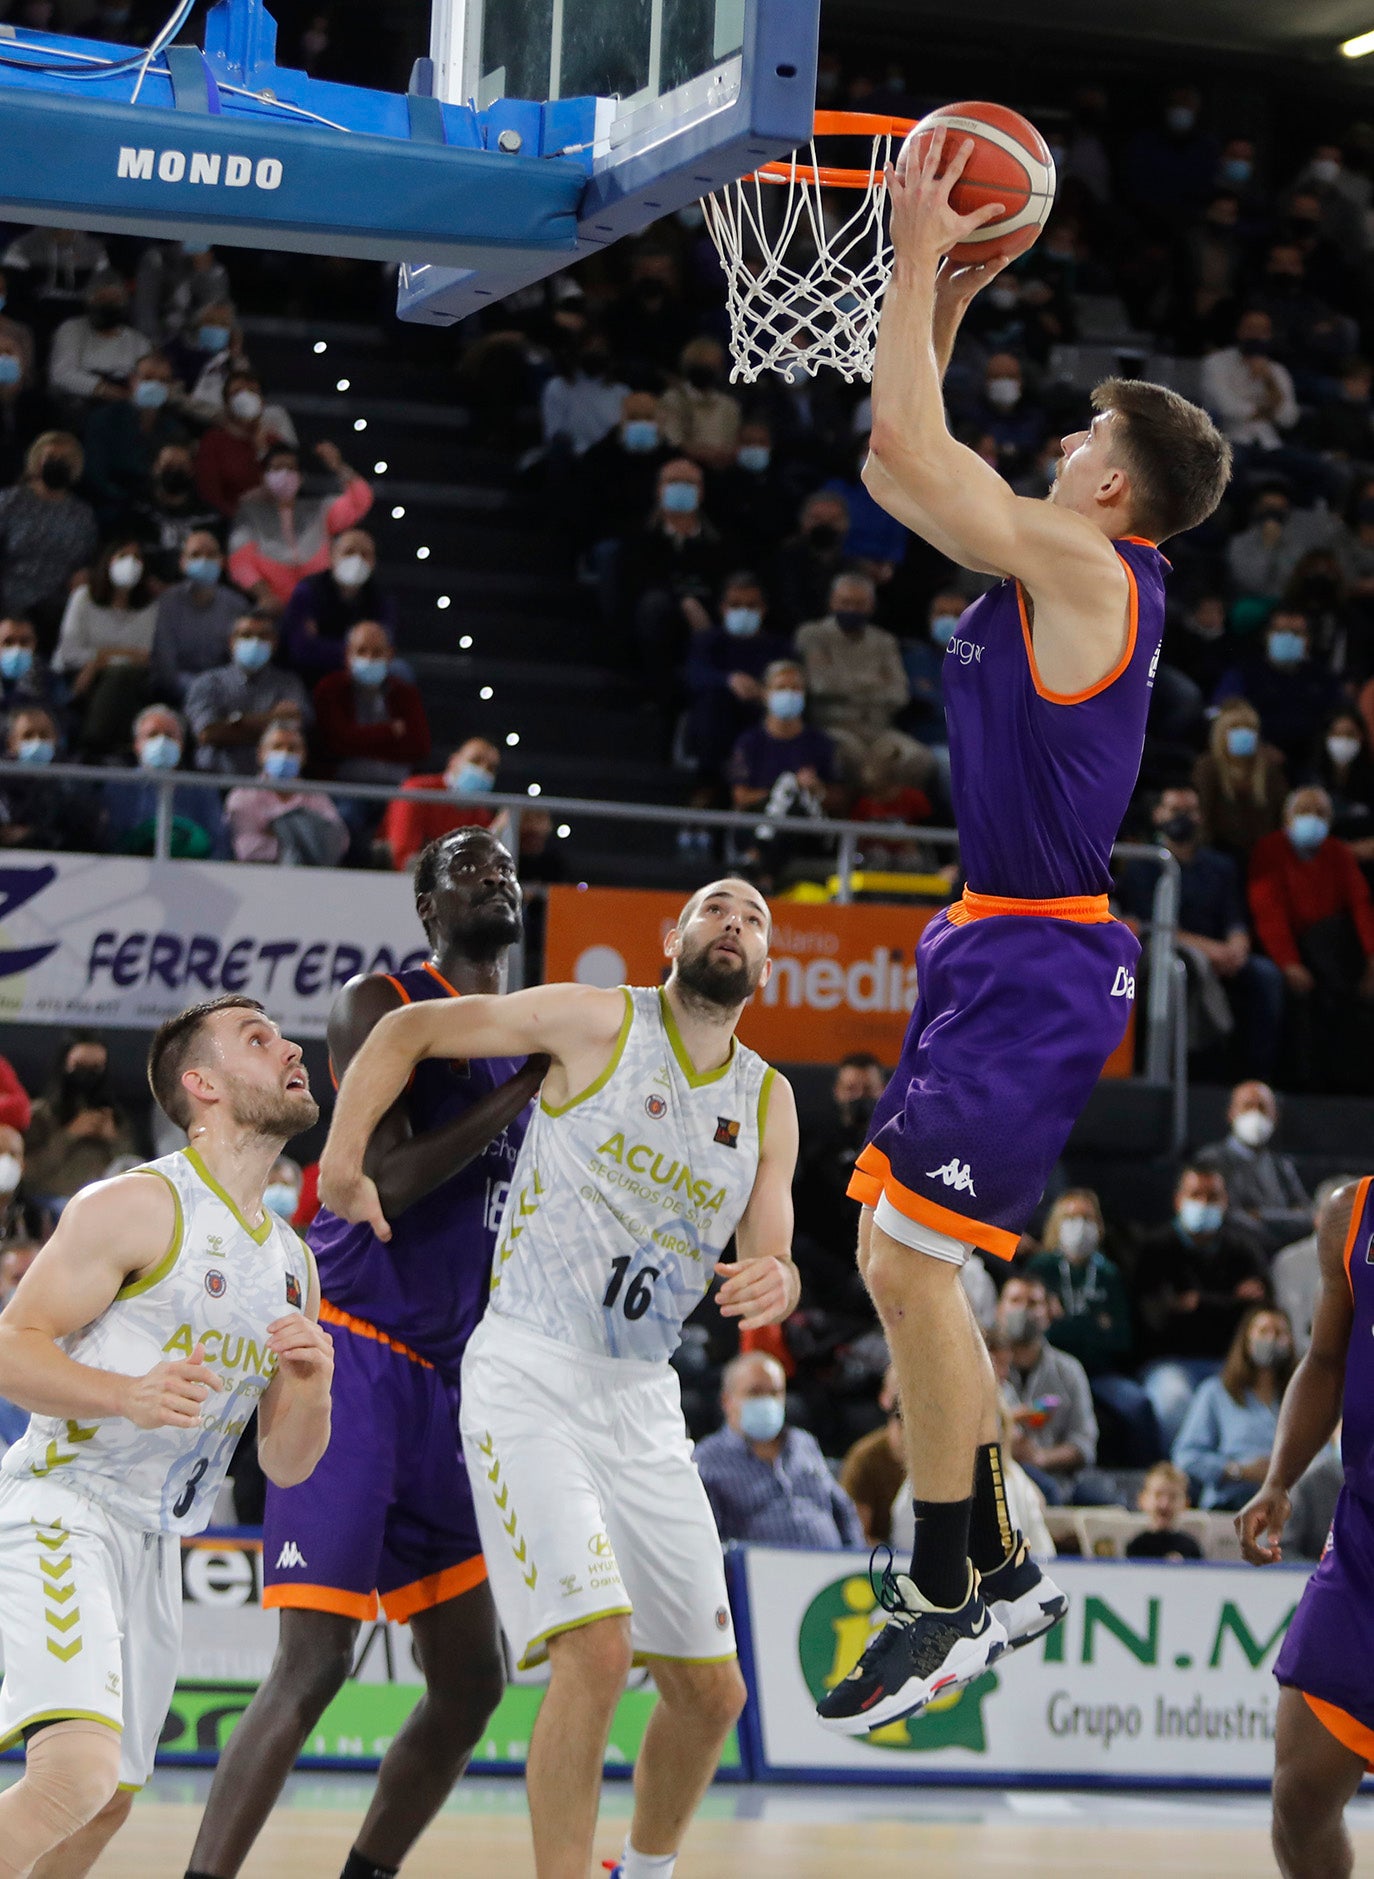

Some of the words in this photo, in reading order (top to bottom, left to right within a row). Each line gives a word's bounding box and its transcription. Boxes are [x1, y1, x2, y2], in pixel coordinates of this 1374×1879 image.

[117, 146, 283, 190] MONDO
[586, 1158, 661, 1204] SEGUROS
[662, 1195, 685, 1214] DE
[596, 1131, 727, 1214] ACUNSA
[602, 1255, 660, 1321] 16
[162, 1323, 279, 1378] ACUNS
[172, 1457, 209, 1518] 3
[1048, 1691, 1142, 1750] Grupo
[1156, 1693, 1276, 1739] Industri
